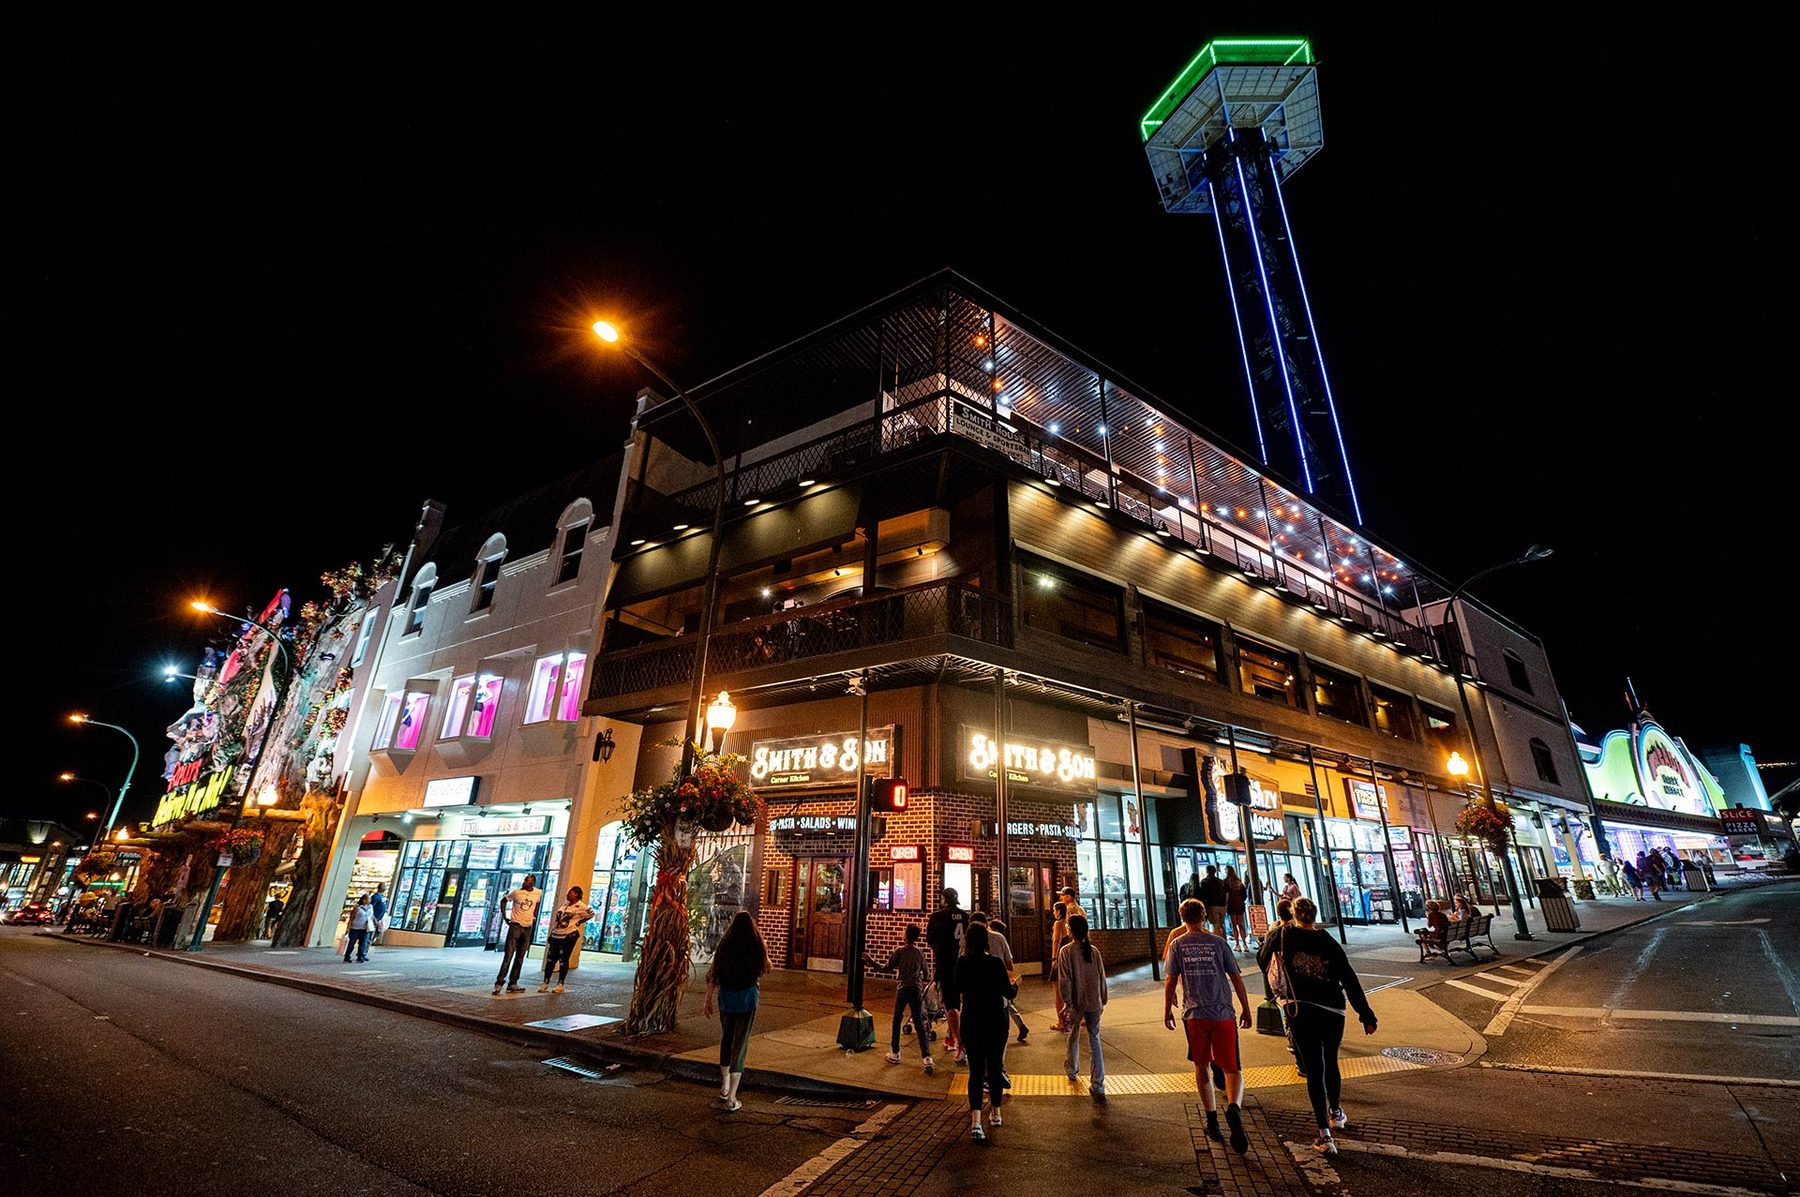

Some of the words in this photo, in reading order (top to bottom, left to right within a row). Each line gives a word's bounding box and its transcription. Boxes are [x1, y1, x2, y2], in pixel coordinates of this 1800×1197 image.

[751, 746, 818, 778] SMITH
[819, 742, 838, 769] &
[1040, 748, 1056, 774] &
[1057, 748, 1096, 782] SON
[770, 775, 789, 785] Corner
[789, 774, 810, 783] Kitchen
[800, 816, 831, 829] SALADS
[837, 817, 856, 829] WIN
[1725, 821, 1757, 829] PIZZA
[1040, 823, 1062, 837] PASTA
[890, 846, 918, 860] OPEN
[948, 846, 975, 861] OPEN
[953, 922, 965, 940] 4
